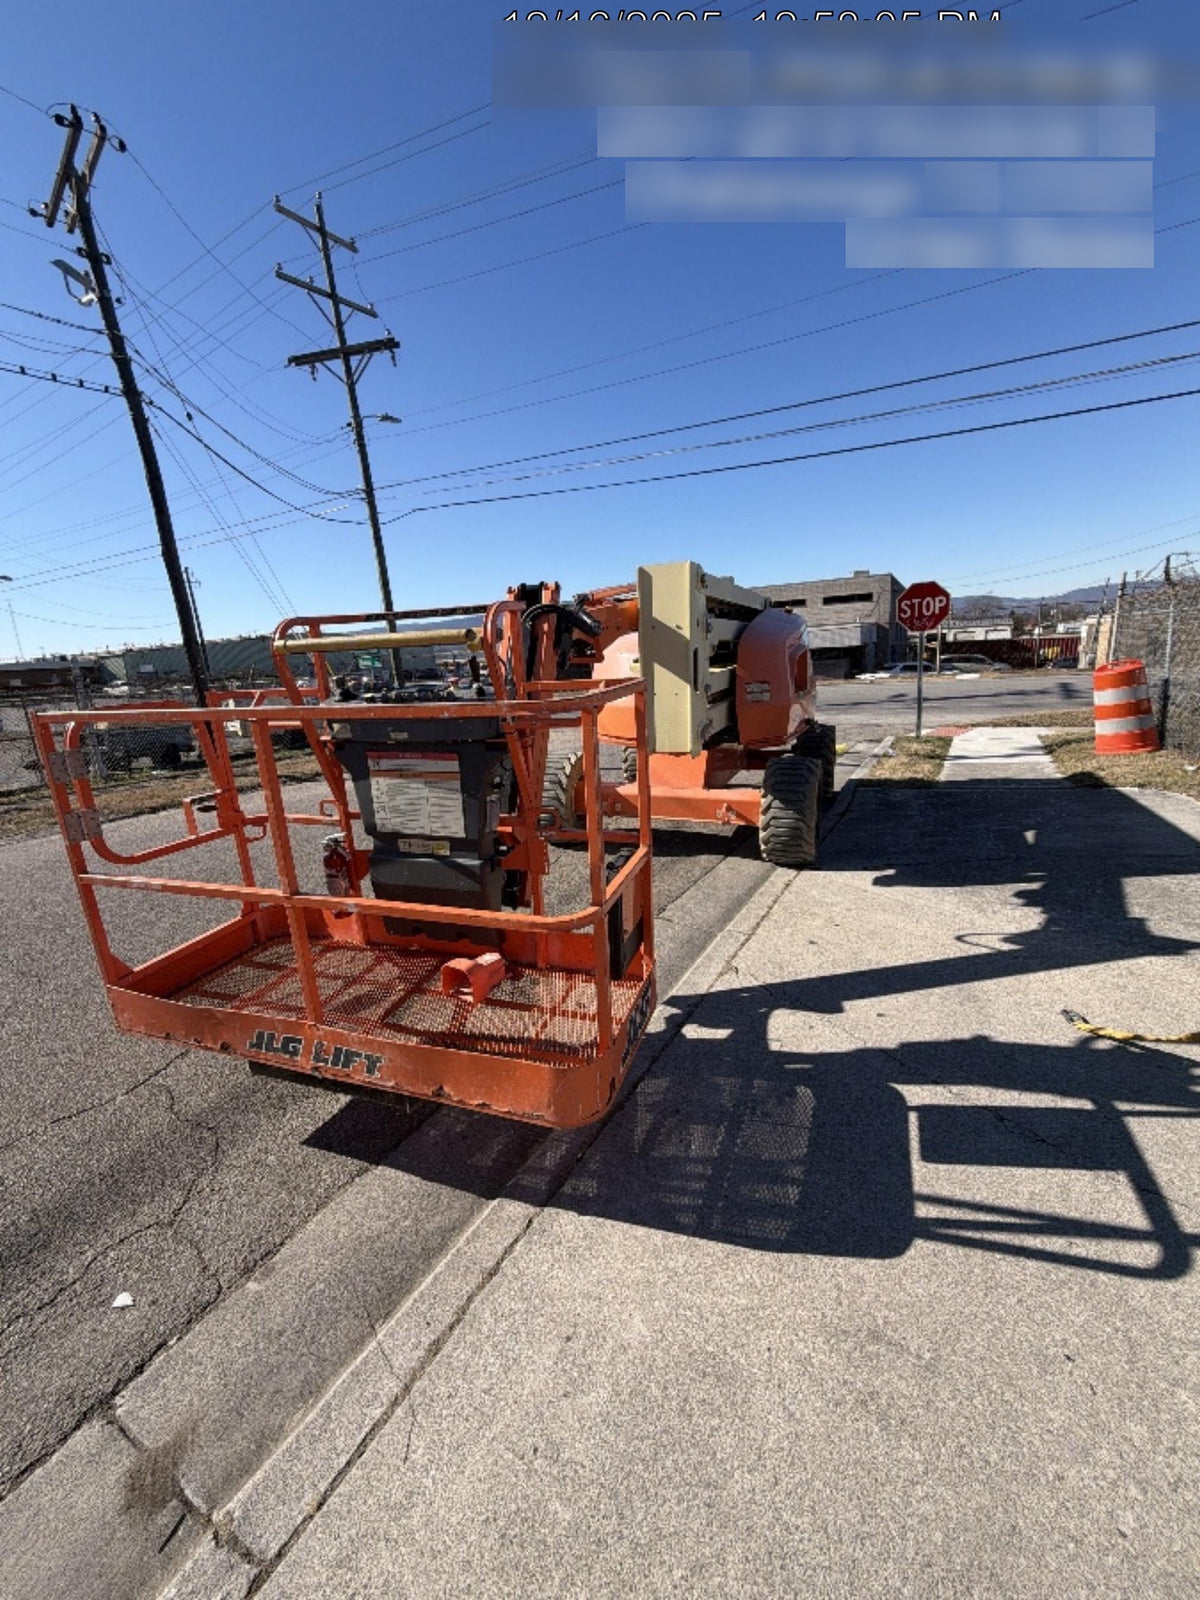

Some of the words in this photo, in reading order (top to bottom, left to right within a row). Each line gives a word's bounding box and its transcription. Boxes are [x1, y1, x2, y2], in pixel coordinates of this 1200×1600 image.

[901, 596, 946, 618] STOP
[247, 1029, 304, 1060] JLG
[312, 1039, 385, 1078] LIFT
